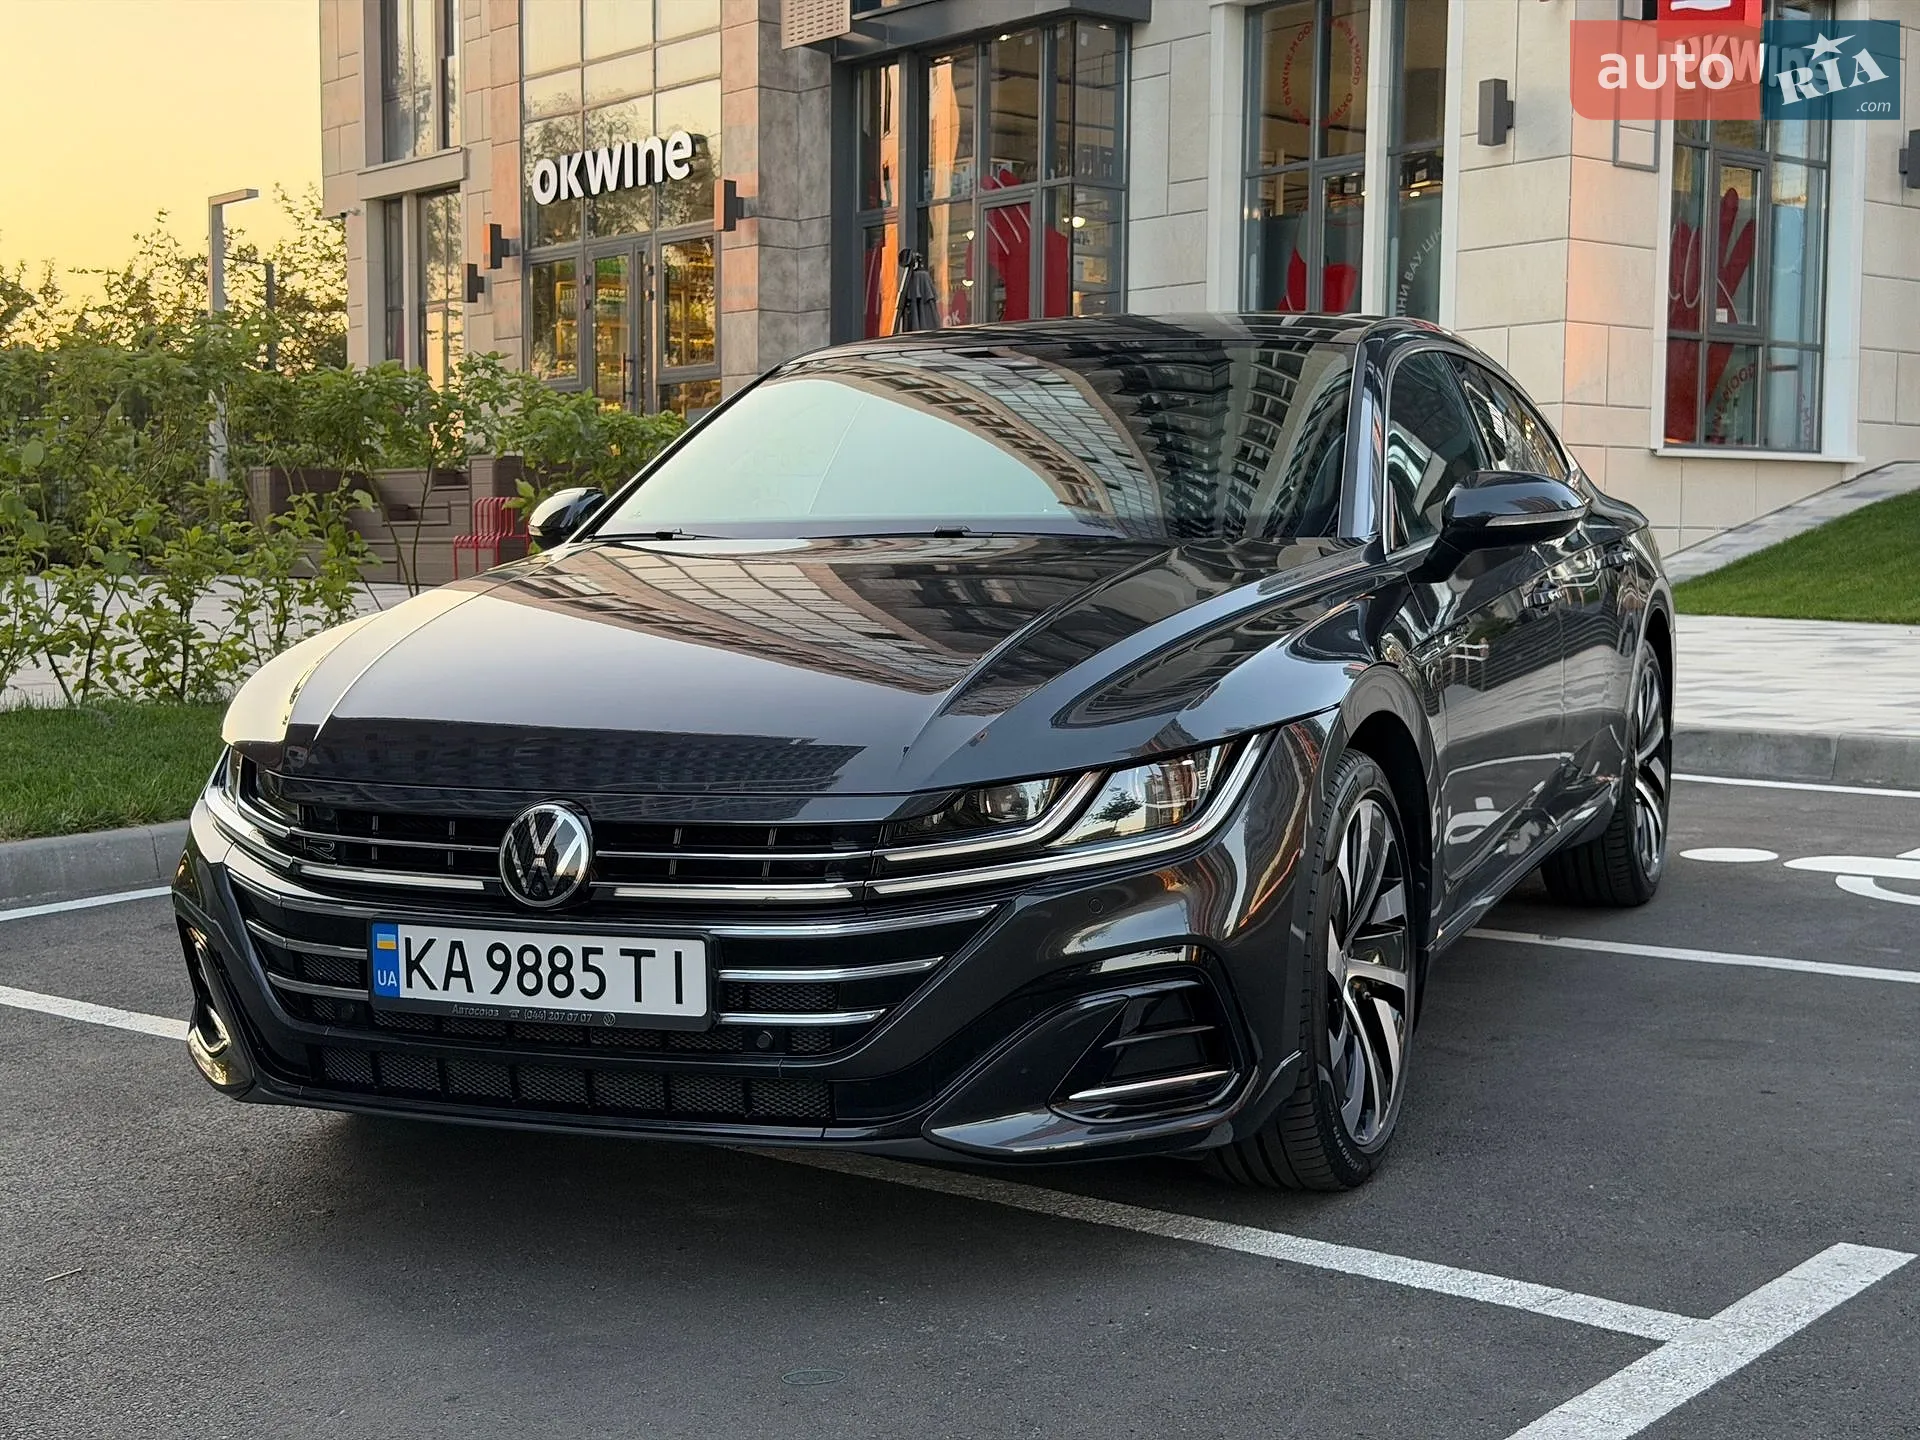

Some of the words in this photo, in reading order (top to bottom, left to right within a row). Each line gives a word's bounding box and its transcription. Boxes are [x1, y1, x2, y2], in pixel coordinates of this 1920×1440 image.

[377, 969, 398, 987] UA
[404, 937, 474, 993] KA
[486, 942, 607, 1000] 9885
[619, 948, 684, 1005] TI
[548, 1010, 565, 1022] 207
[567, 1011, 579, 1022] 07
[580, 1012, 592, 1023] 07
